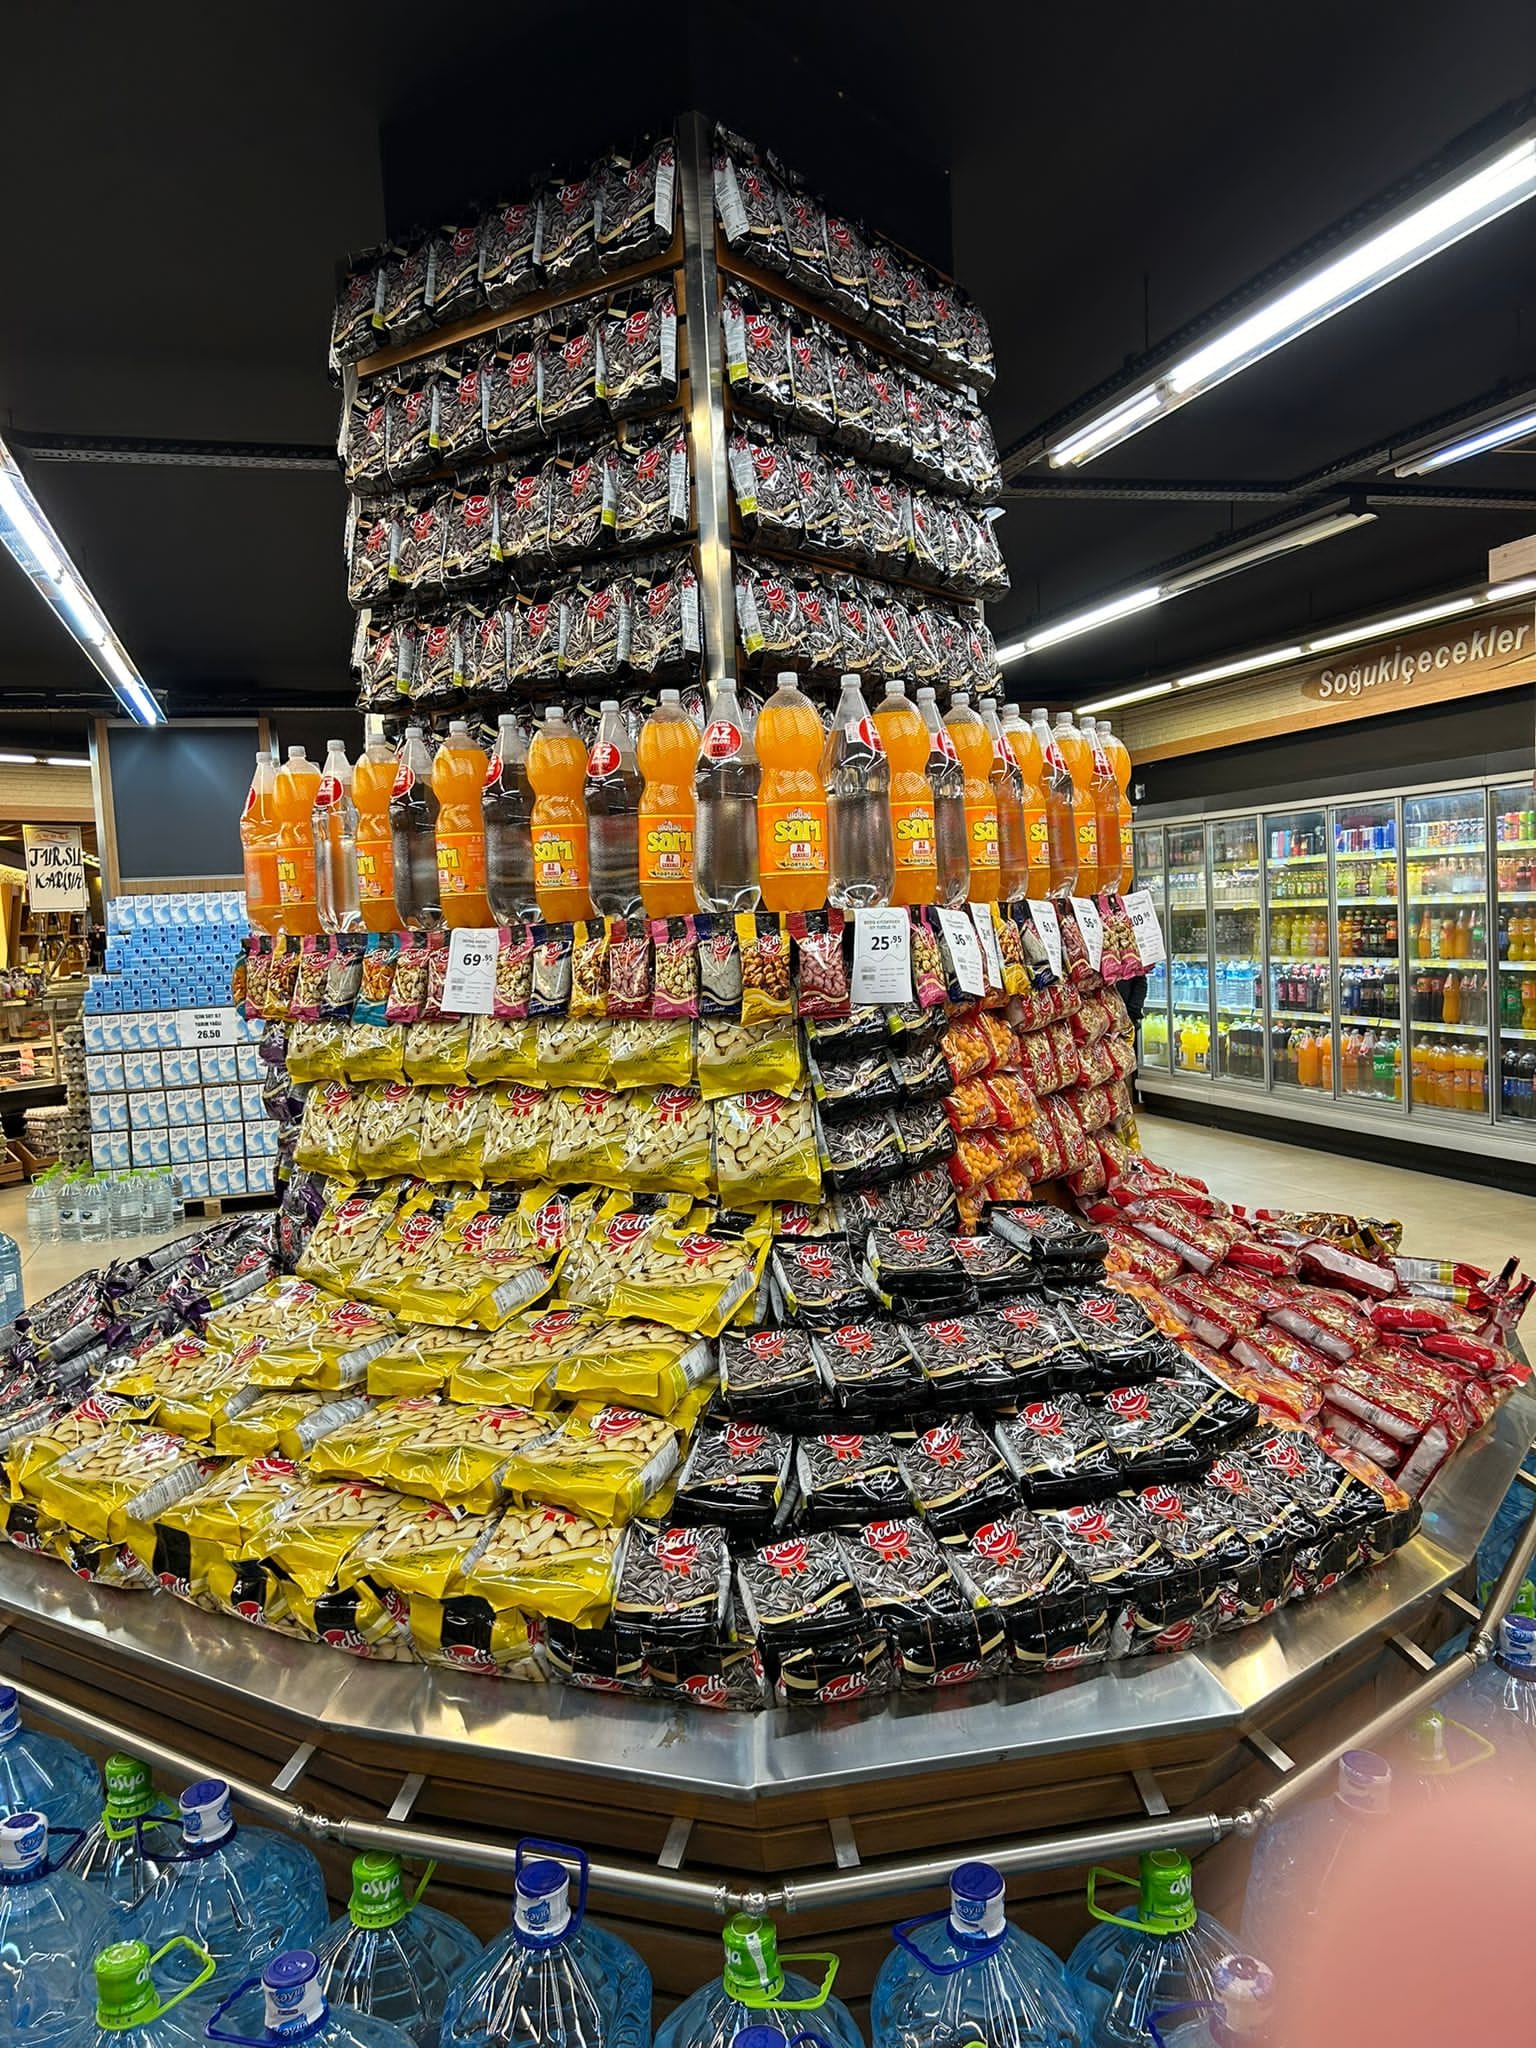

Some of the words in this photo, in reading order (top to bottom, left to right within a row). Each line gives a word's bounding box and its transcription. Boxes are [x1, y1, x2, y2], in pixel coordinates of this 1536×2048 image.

[197, 1029, 221, 1039] 26,50
[783, 1203, 810, 1223] edis
[793, 1245, 834, 1264] Bedis
[743, 1330, 787, 1349] Bedis
[830, 1324, 872, 1344] Bedis
[1104, 1386, 1147, 1410] Bedis
[649, 1527, 704, 1554] Bedis
[859, 1519, 910, 1546] Bedis
[968, 1518, 1012, 1554] Bedis
[330, 1629, 366, 1648] edis
[815, 1672, 869, 1702] Bedis
[361, 1875, 400, 1900] asya
